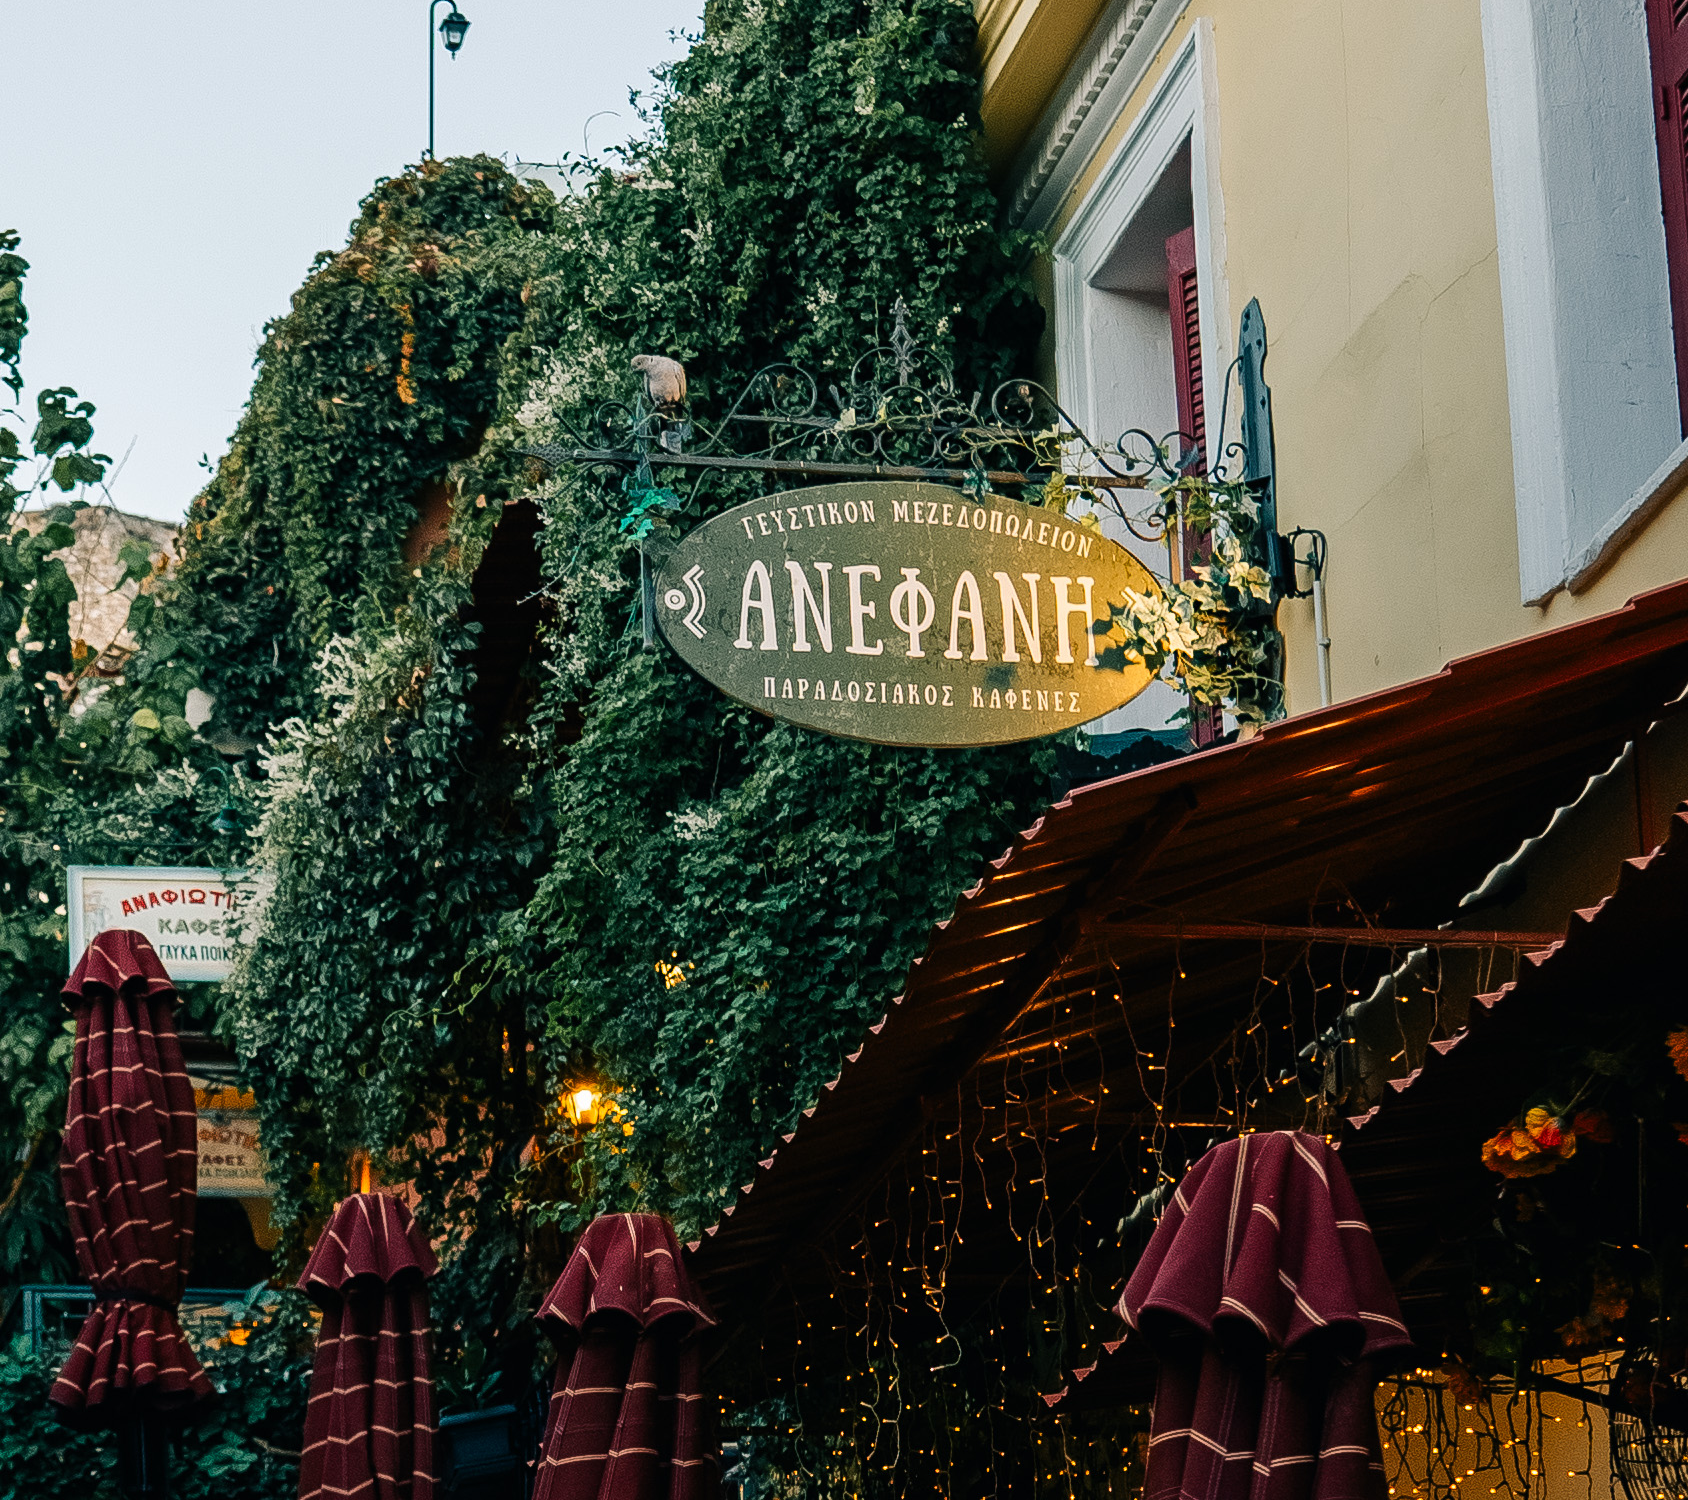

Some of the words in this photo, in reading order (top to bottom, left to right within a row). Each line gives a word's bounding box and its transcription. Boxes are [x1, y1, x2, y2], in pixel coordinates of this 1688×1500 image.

[740, 500, 876, 540] ΓΕΥΣΤΙΚΟΝ
[892, 500, 1093, 558] ΜΕΖΕΔΟΠΩΛΕΙΟΝ
[733, 560, 1100, 667] ΑΝΕΦΑΝΗ
[764, 677, 954, 707] ΠΑΡΑΔΟΣΙΑΚΟΣ
[971, 687, 1080, 713] ΚΑΦΕΝΕΣ
[198, 1153, 244, 1166] ΑΦΕΣ
